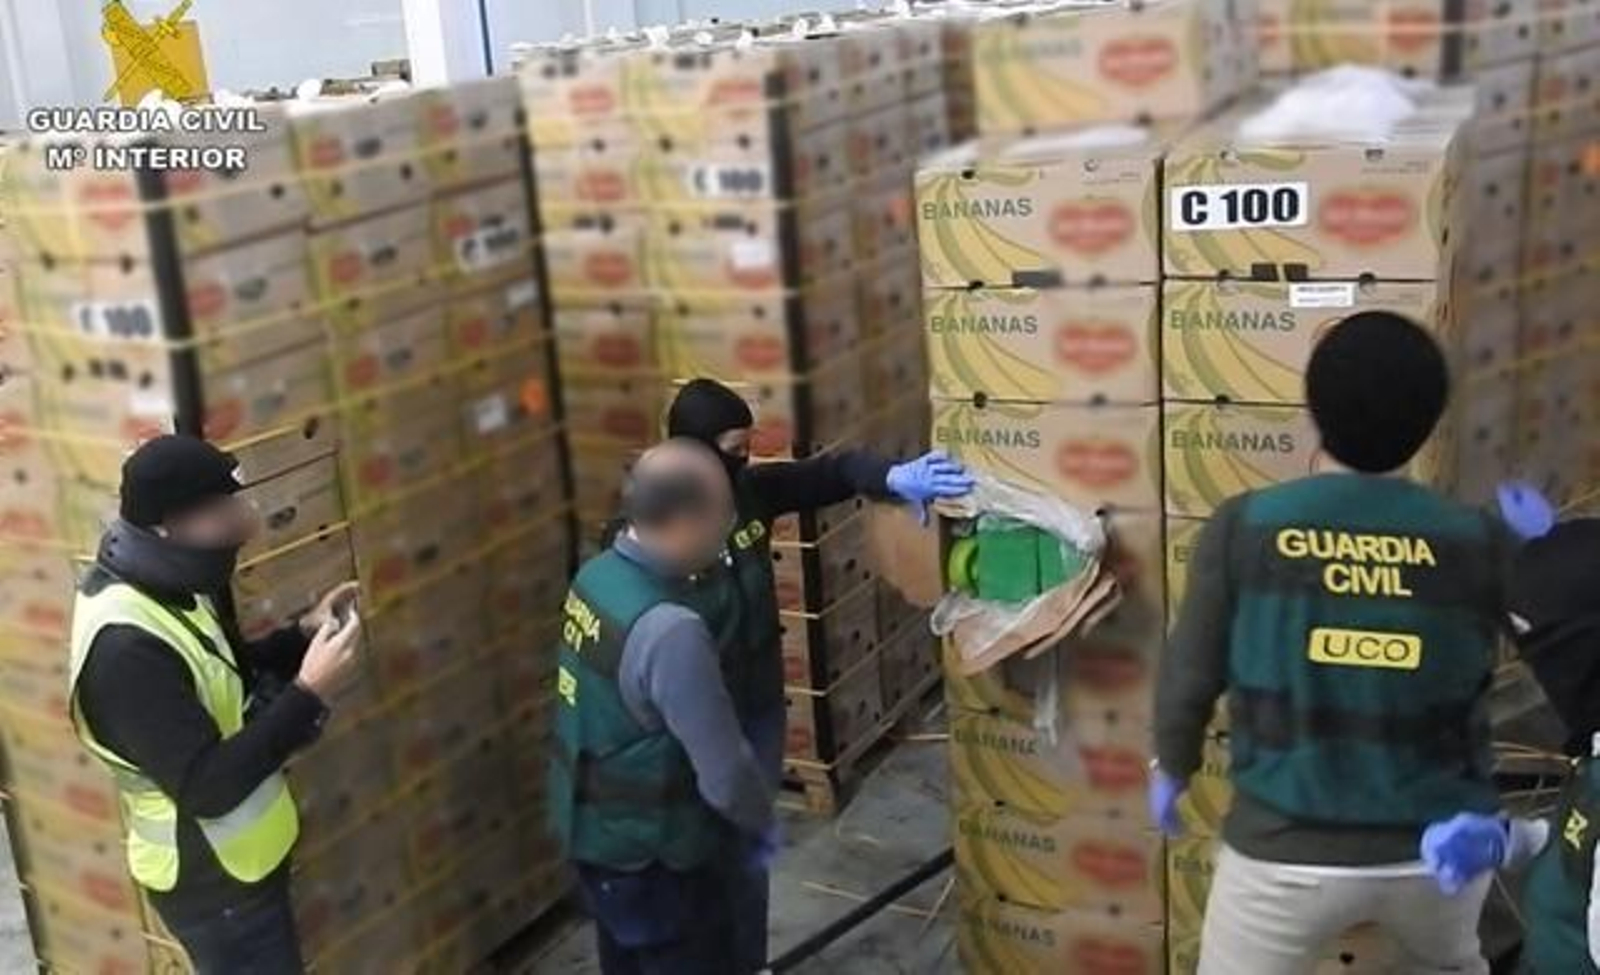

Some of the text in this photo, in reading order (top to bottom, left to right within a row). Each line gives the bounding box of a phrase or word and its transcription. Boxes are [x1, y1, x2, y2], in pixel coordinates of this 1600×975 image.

[923, 198, 1033, 219] BANANAS
[1181, 190, 1208, 225] C
[1219, 187, 1300, 223] 100
[930, 315, 1038, 335] BANANAS
[1170, 310, 1296, 332] BANANAS
[935, 426, 1041, 448] BANANAS
[1171, 429, 1295, 453] BANANAS
[1276, 528, 1436, 566] GUARDIA
[1323, 563, 1412, 597] CIVIL
[1322, 633, 1410, 662] UCO
